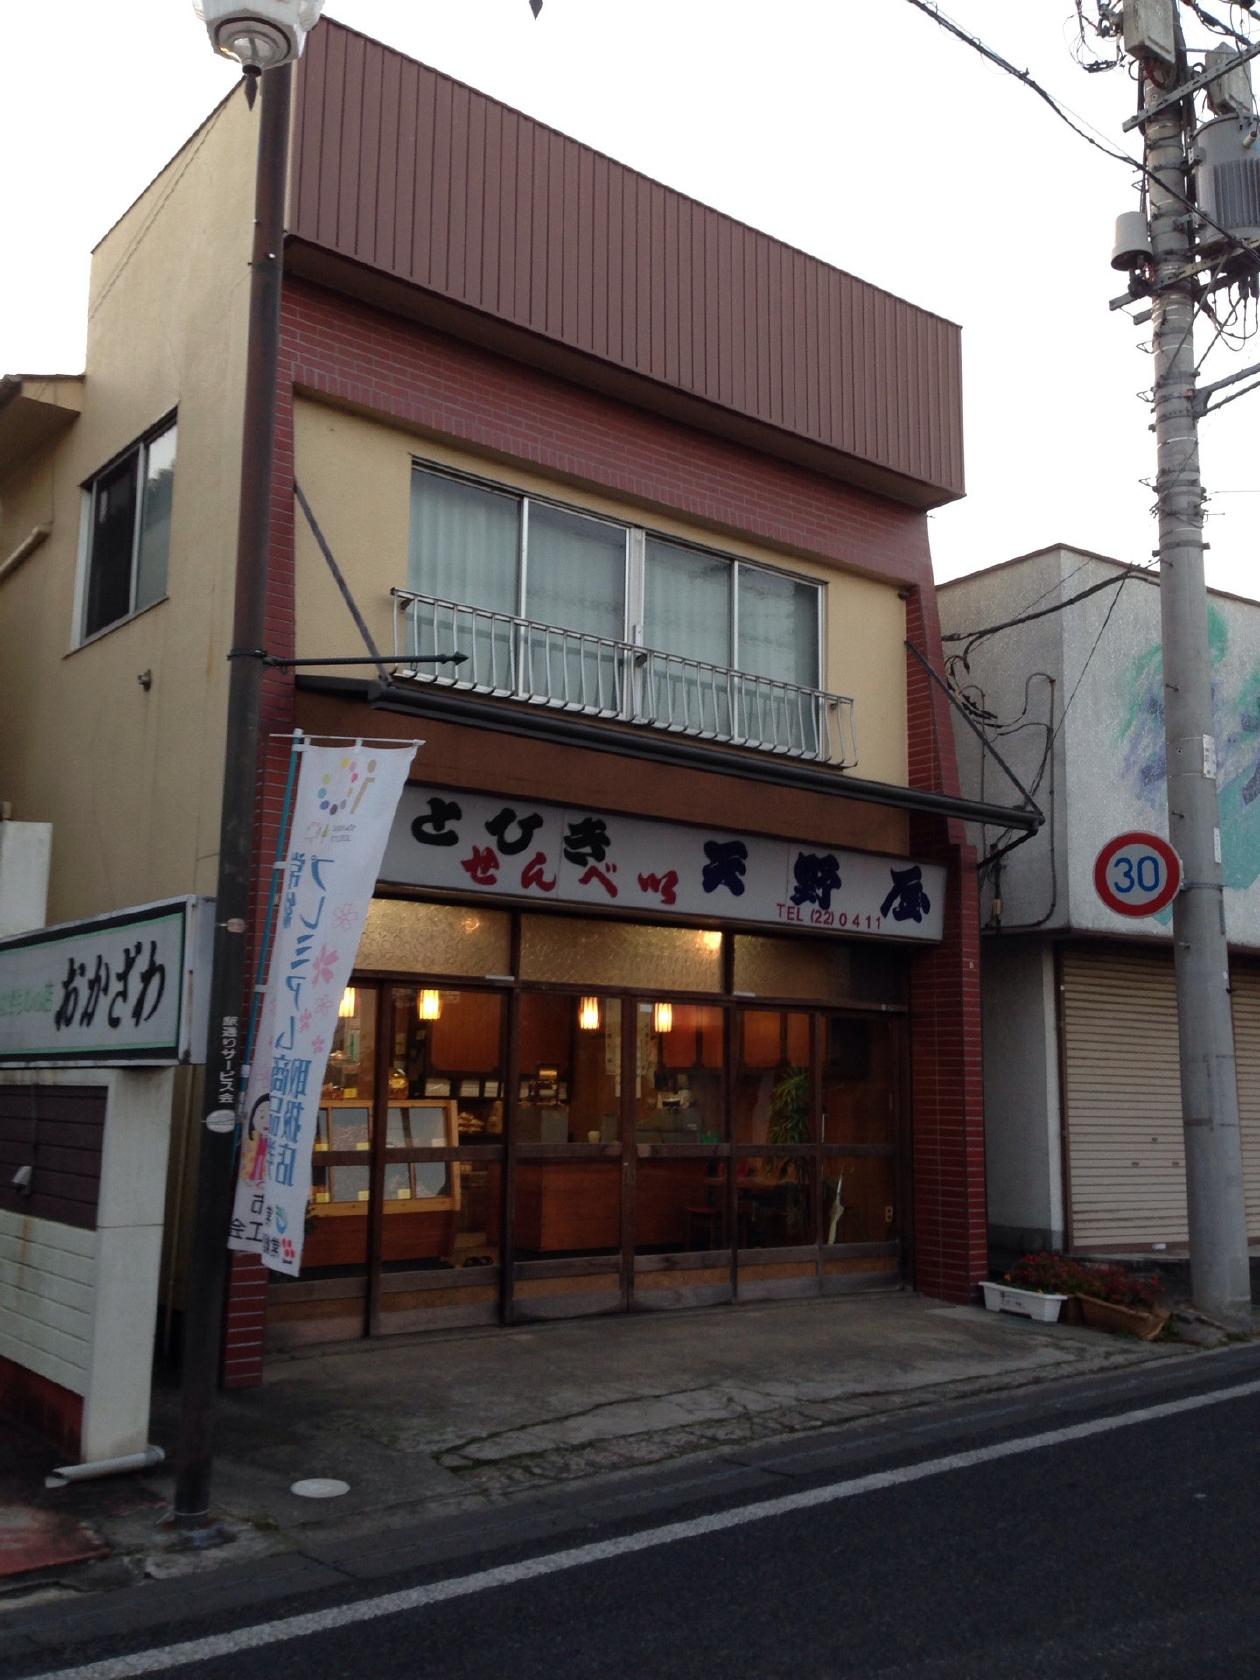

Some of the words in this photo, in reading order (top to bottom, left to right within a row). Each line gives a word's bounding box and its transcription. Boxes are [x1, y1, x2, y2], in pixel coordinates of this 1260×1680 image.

[1114, 856, 1160, 893] 30
[776, 903, 803, 921] TEL
[54, 940, 166, 1031] おかざわ
